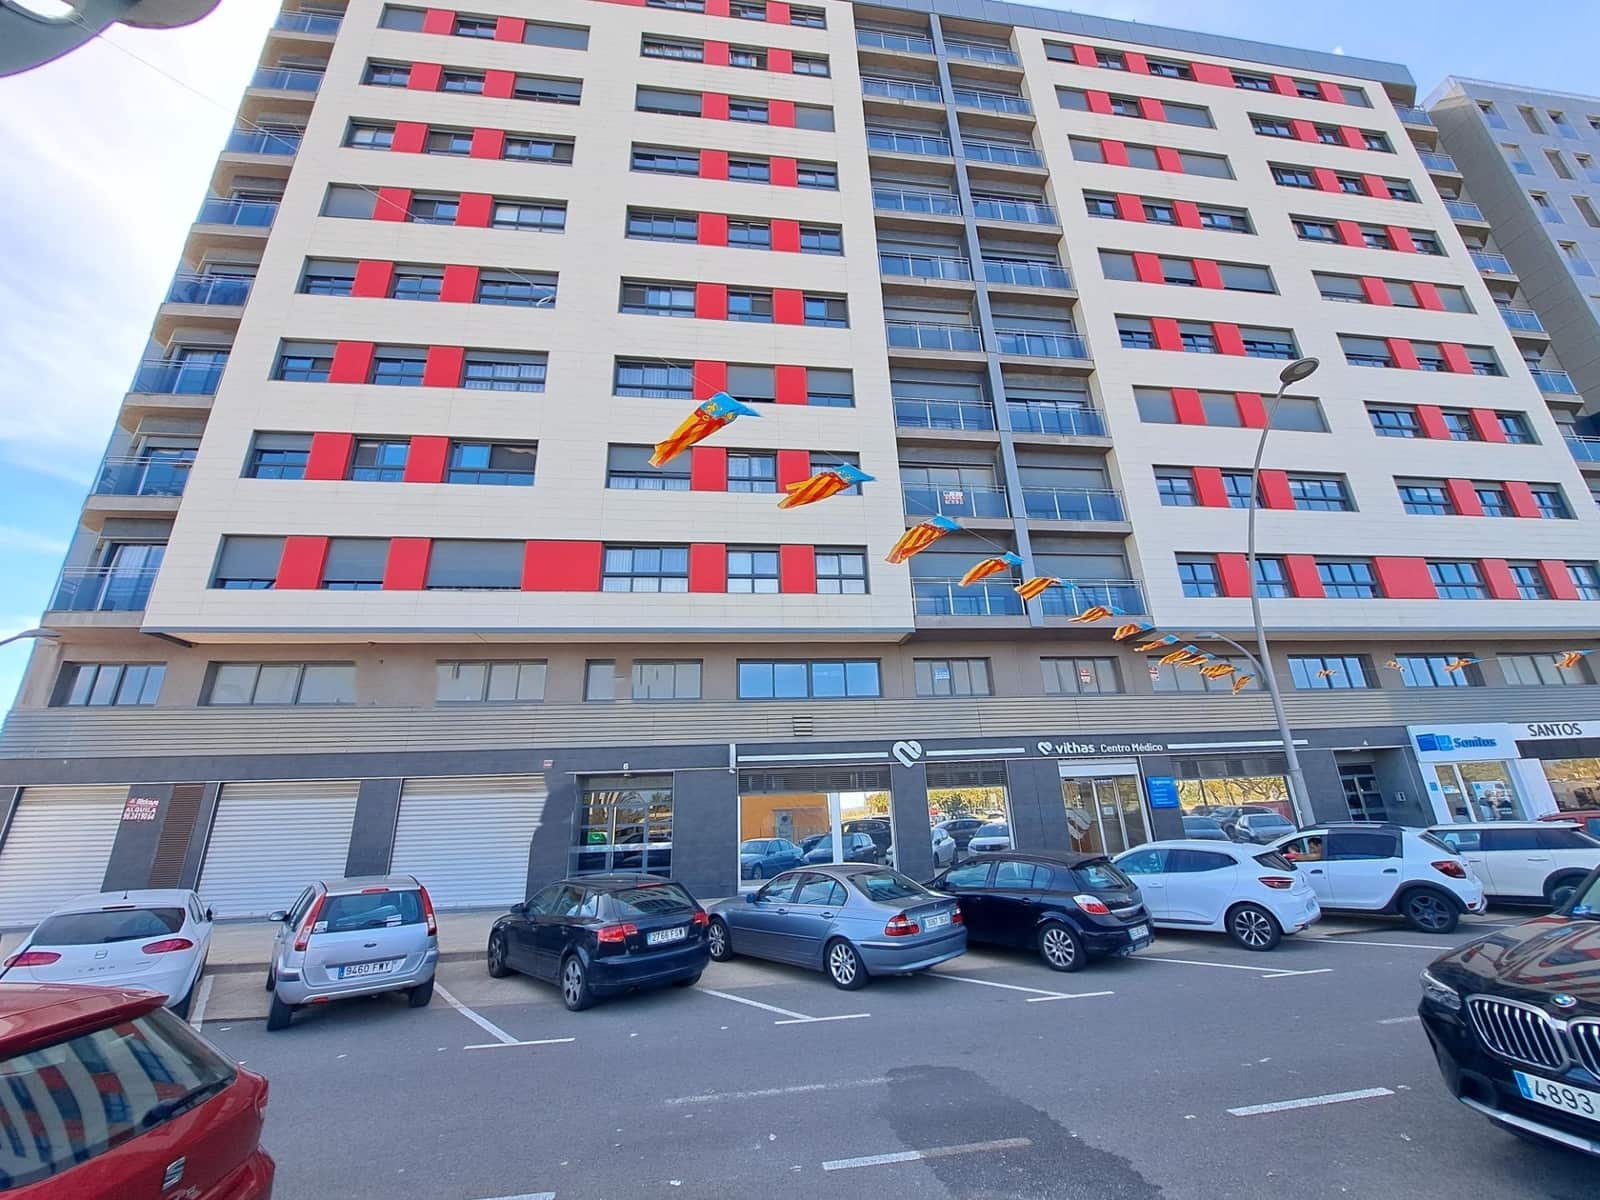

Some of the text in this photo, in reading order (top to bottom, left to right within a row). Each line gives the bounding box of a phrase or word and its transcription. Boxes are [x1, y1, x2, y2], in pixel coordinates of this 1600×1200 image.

[1527, 723, 1583, 737] SANTOS
[1055, 742, 1164, 754] vithas Centro Médico
[1453, 736, 1497, 749] Sanitas
[345, 964, 370, 976] 9460
[1534, 1080, 1595, 1115] 4893
